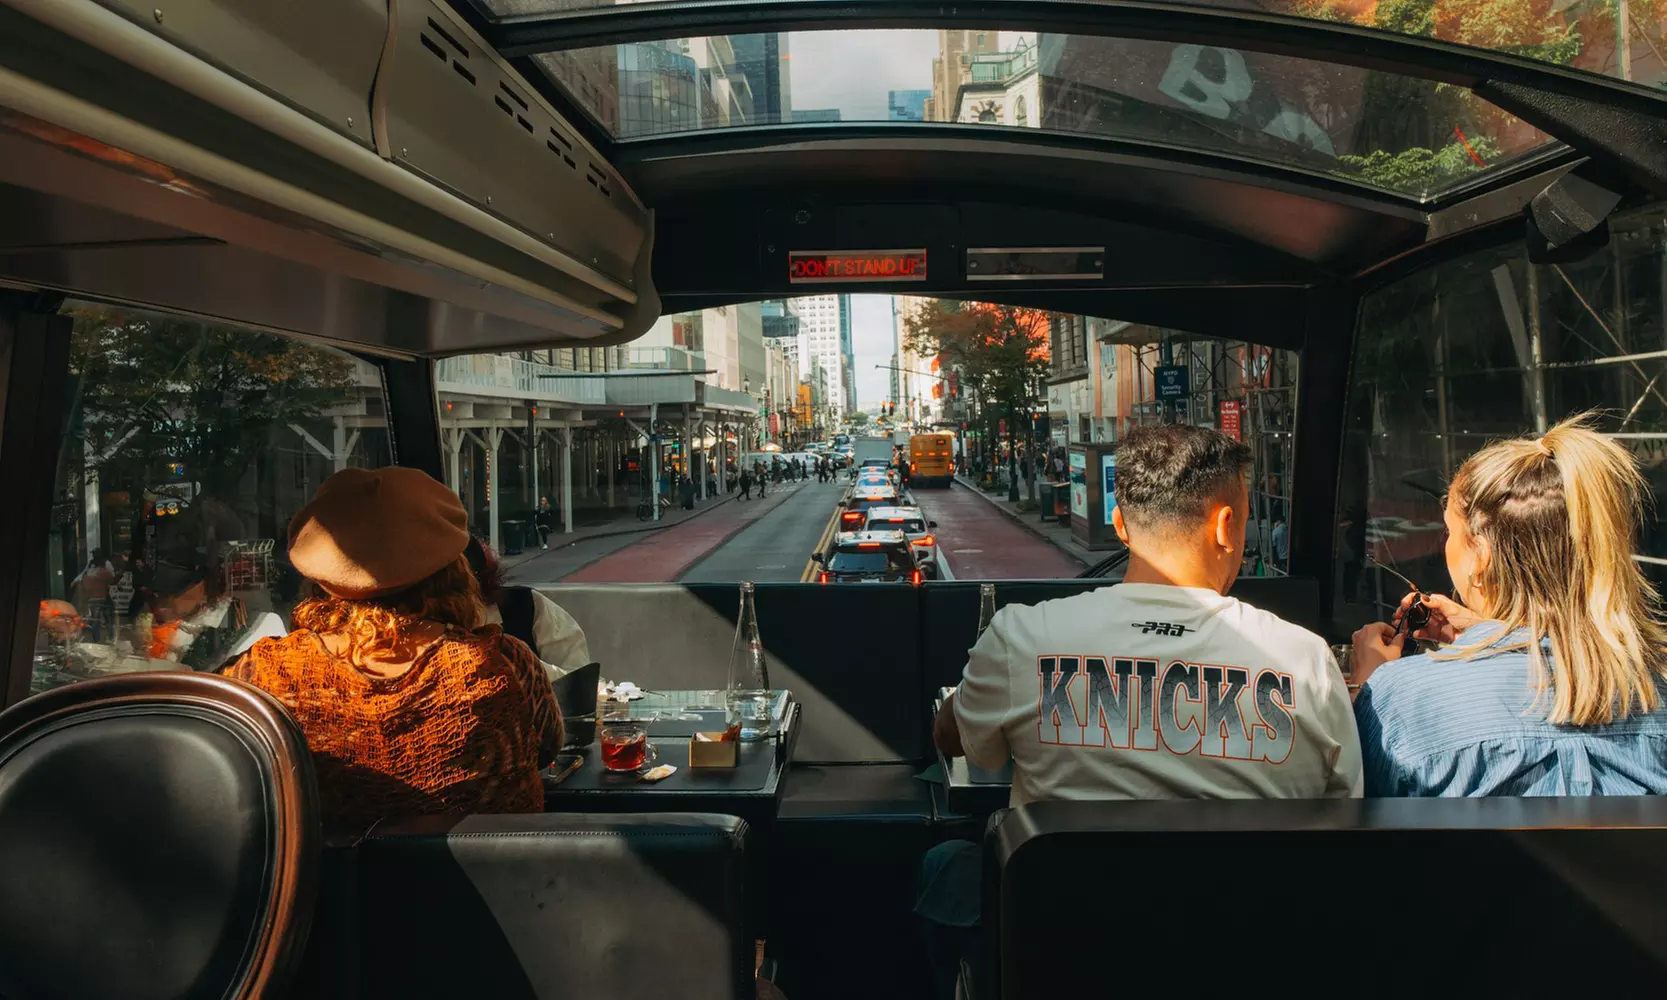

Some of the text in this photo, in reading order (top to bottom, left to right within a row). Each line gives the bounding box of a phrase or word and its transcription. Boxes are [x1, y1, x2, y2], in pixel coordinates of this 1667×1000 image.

[845, 259, 896, 275] STAND
[899, 258, 920, 275] UP
[1037, 655, 1296, 765] KNICKS
